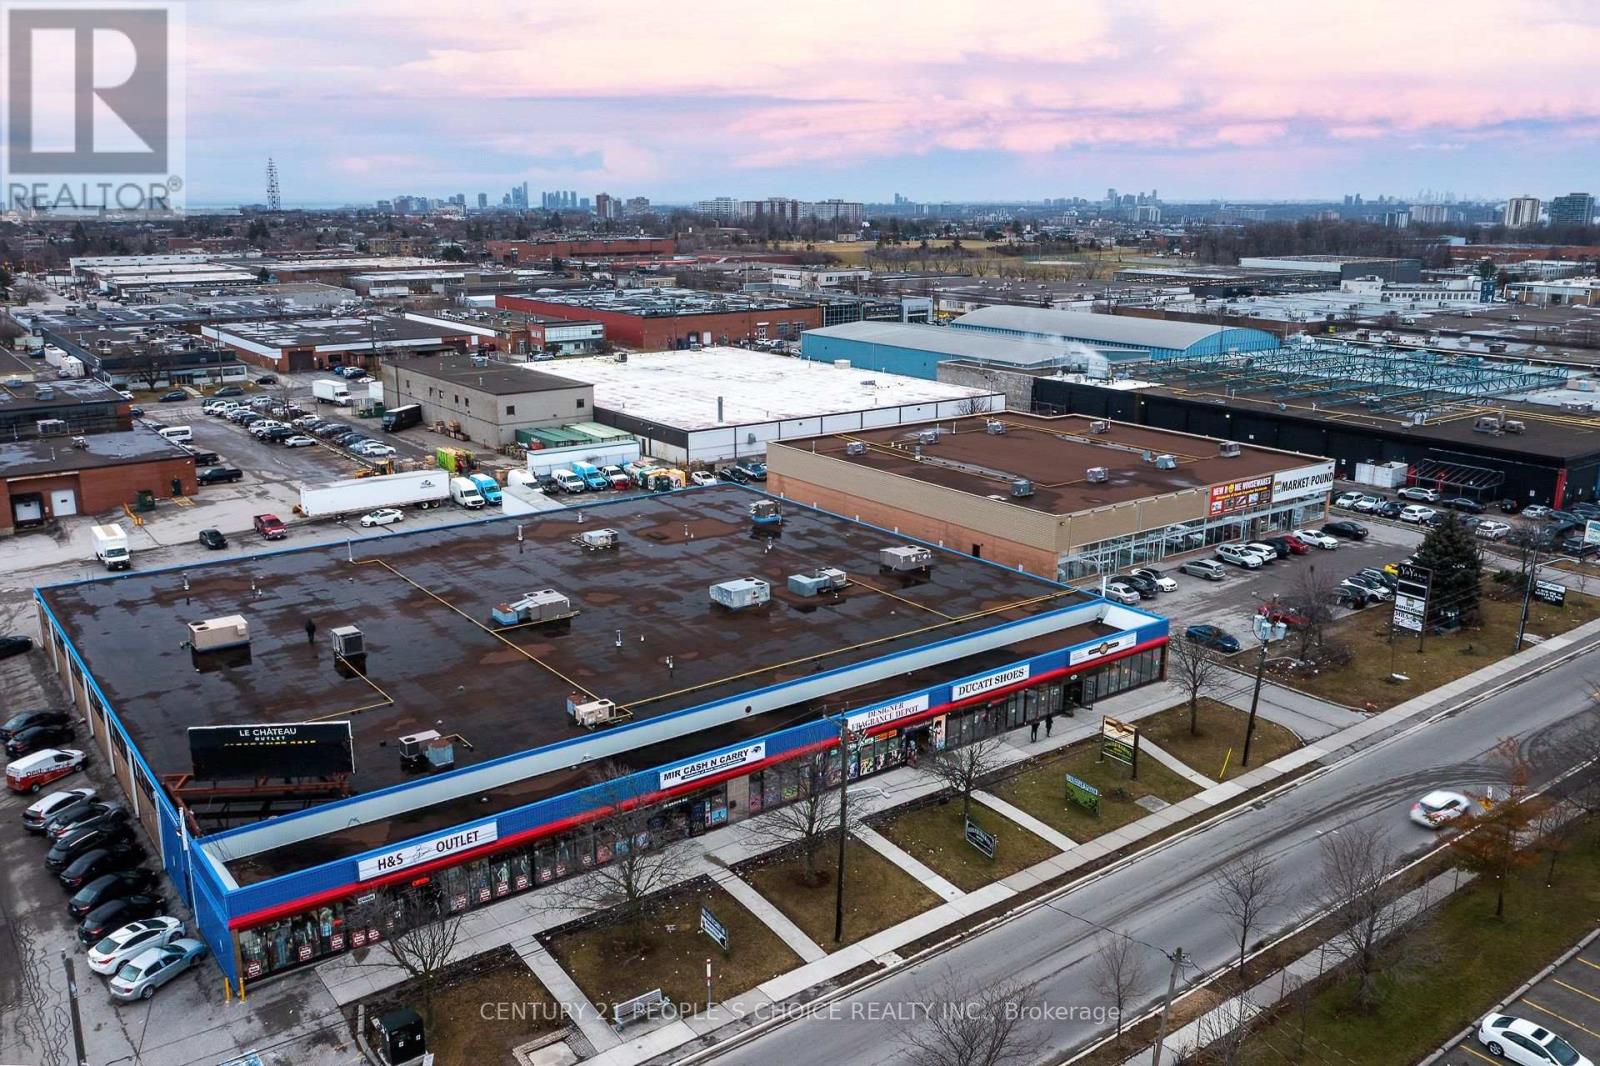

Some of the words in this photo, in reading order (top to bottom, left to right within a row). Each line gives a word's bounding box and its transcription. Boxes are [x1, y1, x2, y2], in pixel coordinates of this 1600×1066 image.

[1281, 476, 1310, 492] MARKET
[1310, 472, 1334, 486] POUND
[958, 677, 993, 696] DUCATI
[994, 668, 1025, 684] SHOES
[851, 712, 893, 730] FRAGRANCE
[896, 705, 919, 717] DEPOT
[868, 702, 904, 718] DESIGNER
[239, 729, 251, 737] LE
[664, 769, 681, 781] MIR
[683, 761, 708, 775] CASH
[710, 758, 717, 766] N
[719, 749, 749, 764] CARRY
[377, 853, 403, 871] H&S
[436, 830, 480, 853] OUTLET
